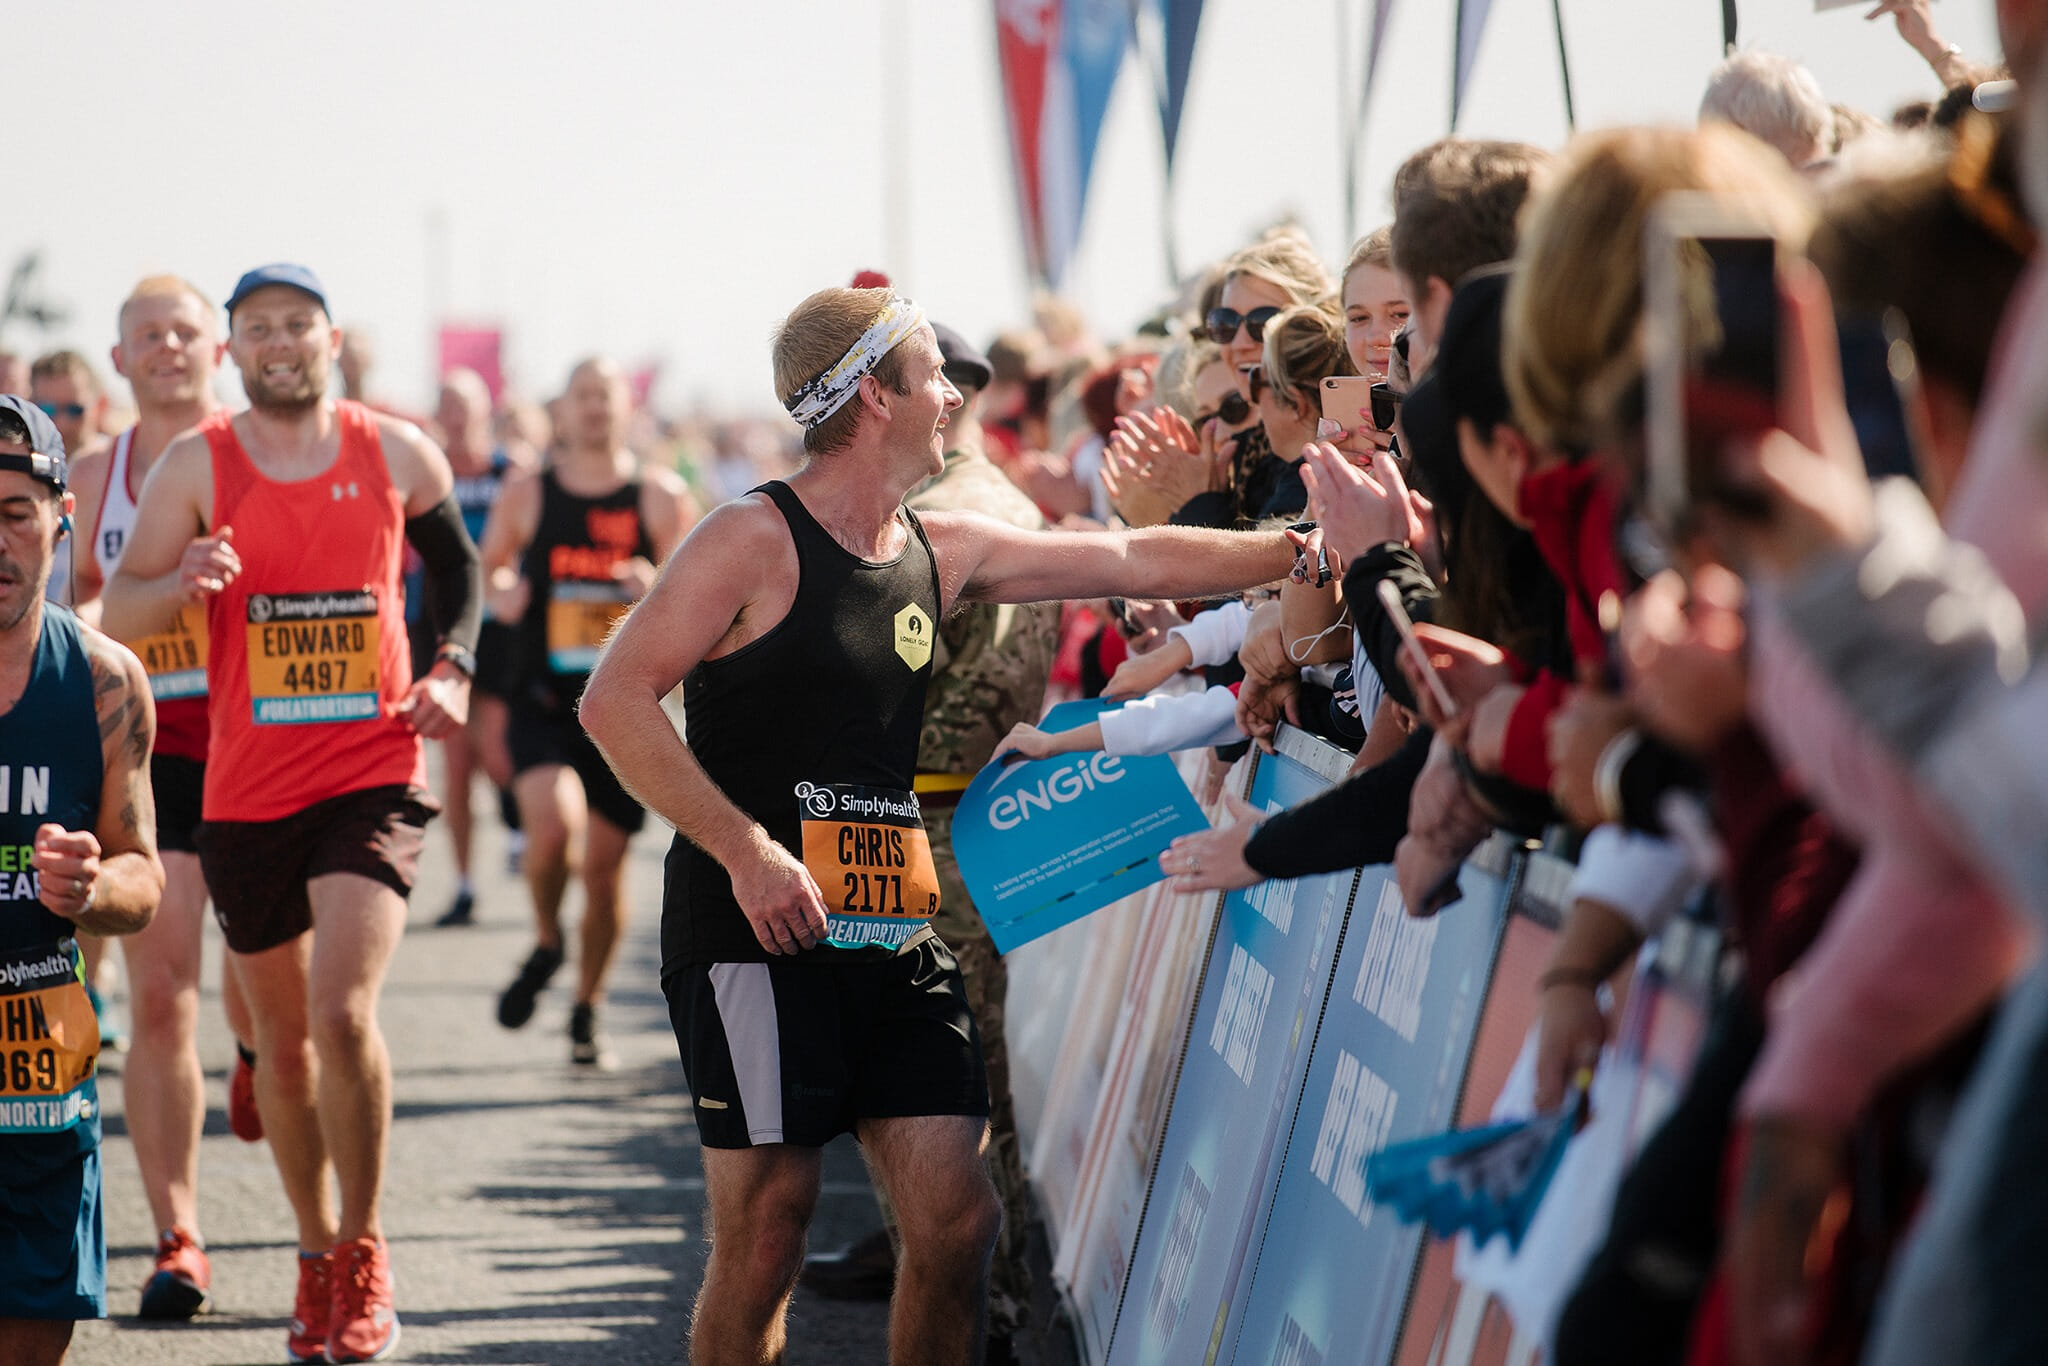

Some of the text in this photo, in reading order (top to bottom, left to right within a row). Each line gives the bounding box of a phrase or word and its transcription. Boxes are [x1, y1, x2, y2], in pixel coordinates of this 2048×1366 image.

[263, 623, 365, 656] EDWARD
[284, 660, 347, 692] 4497
[841, 794, 921, 819] Simplyhealth
[838, 825, 906, 868] CHRIS
[843, 872, 905, 914] 2171
[928, 893, 937, 914] B
[0, 995, 50, 1040] HN
